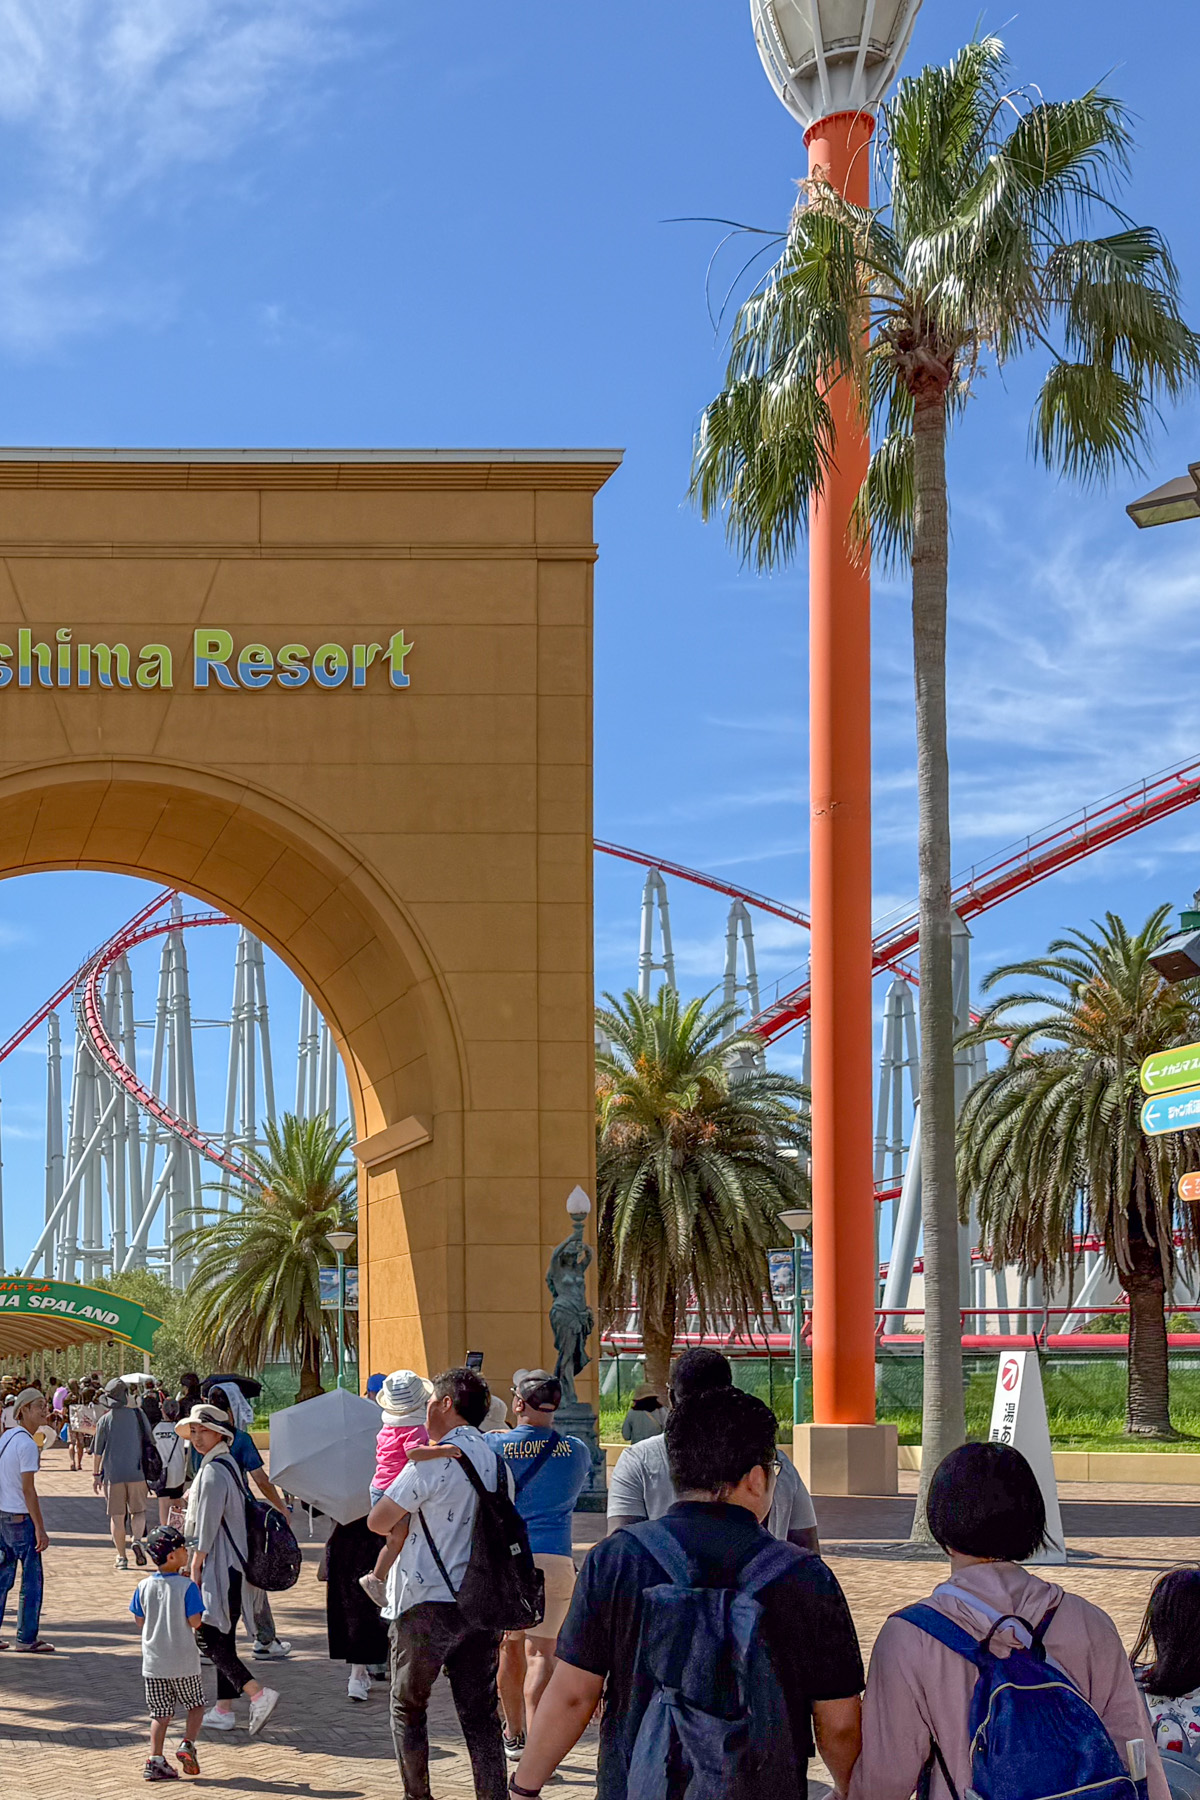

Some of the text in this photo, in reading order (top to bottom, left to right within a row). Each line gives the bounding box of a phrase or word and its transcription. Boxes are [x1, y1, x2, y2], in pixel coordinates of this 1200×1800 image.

[194, 628, 414, 691] Resort
[1160, 1057, 1200, 1078] ナガシマス
[27, 1295, 120, 1325] SPALAND
